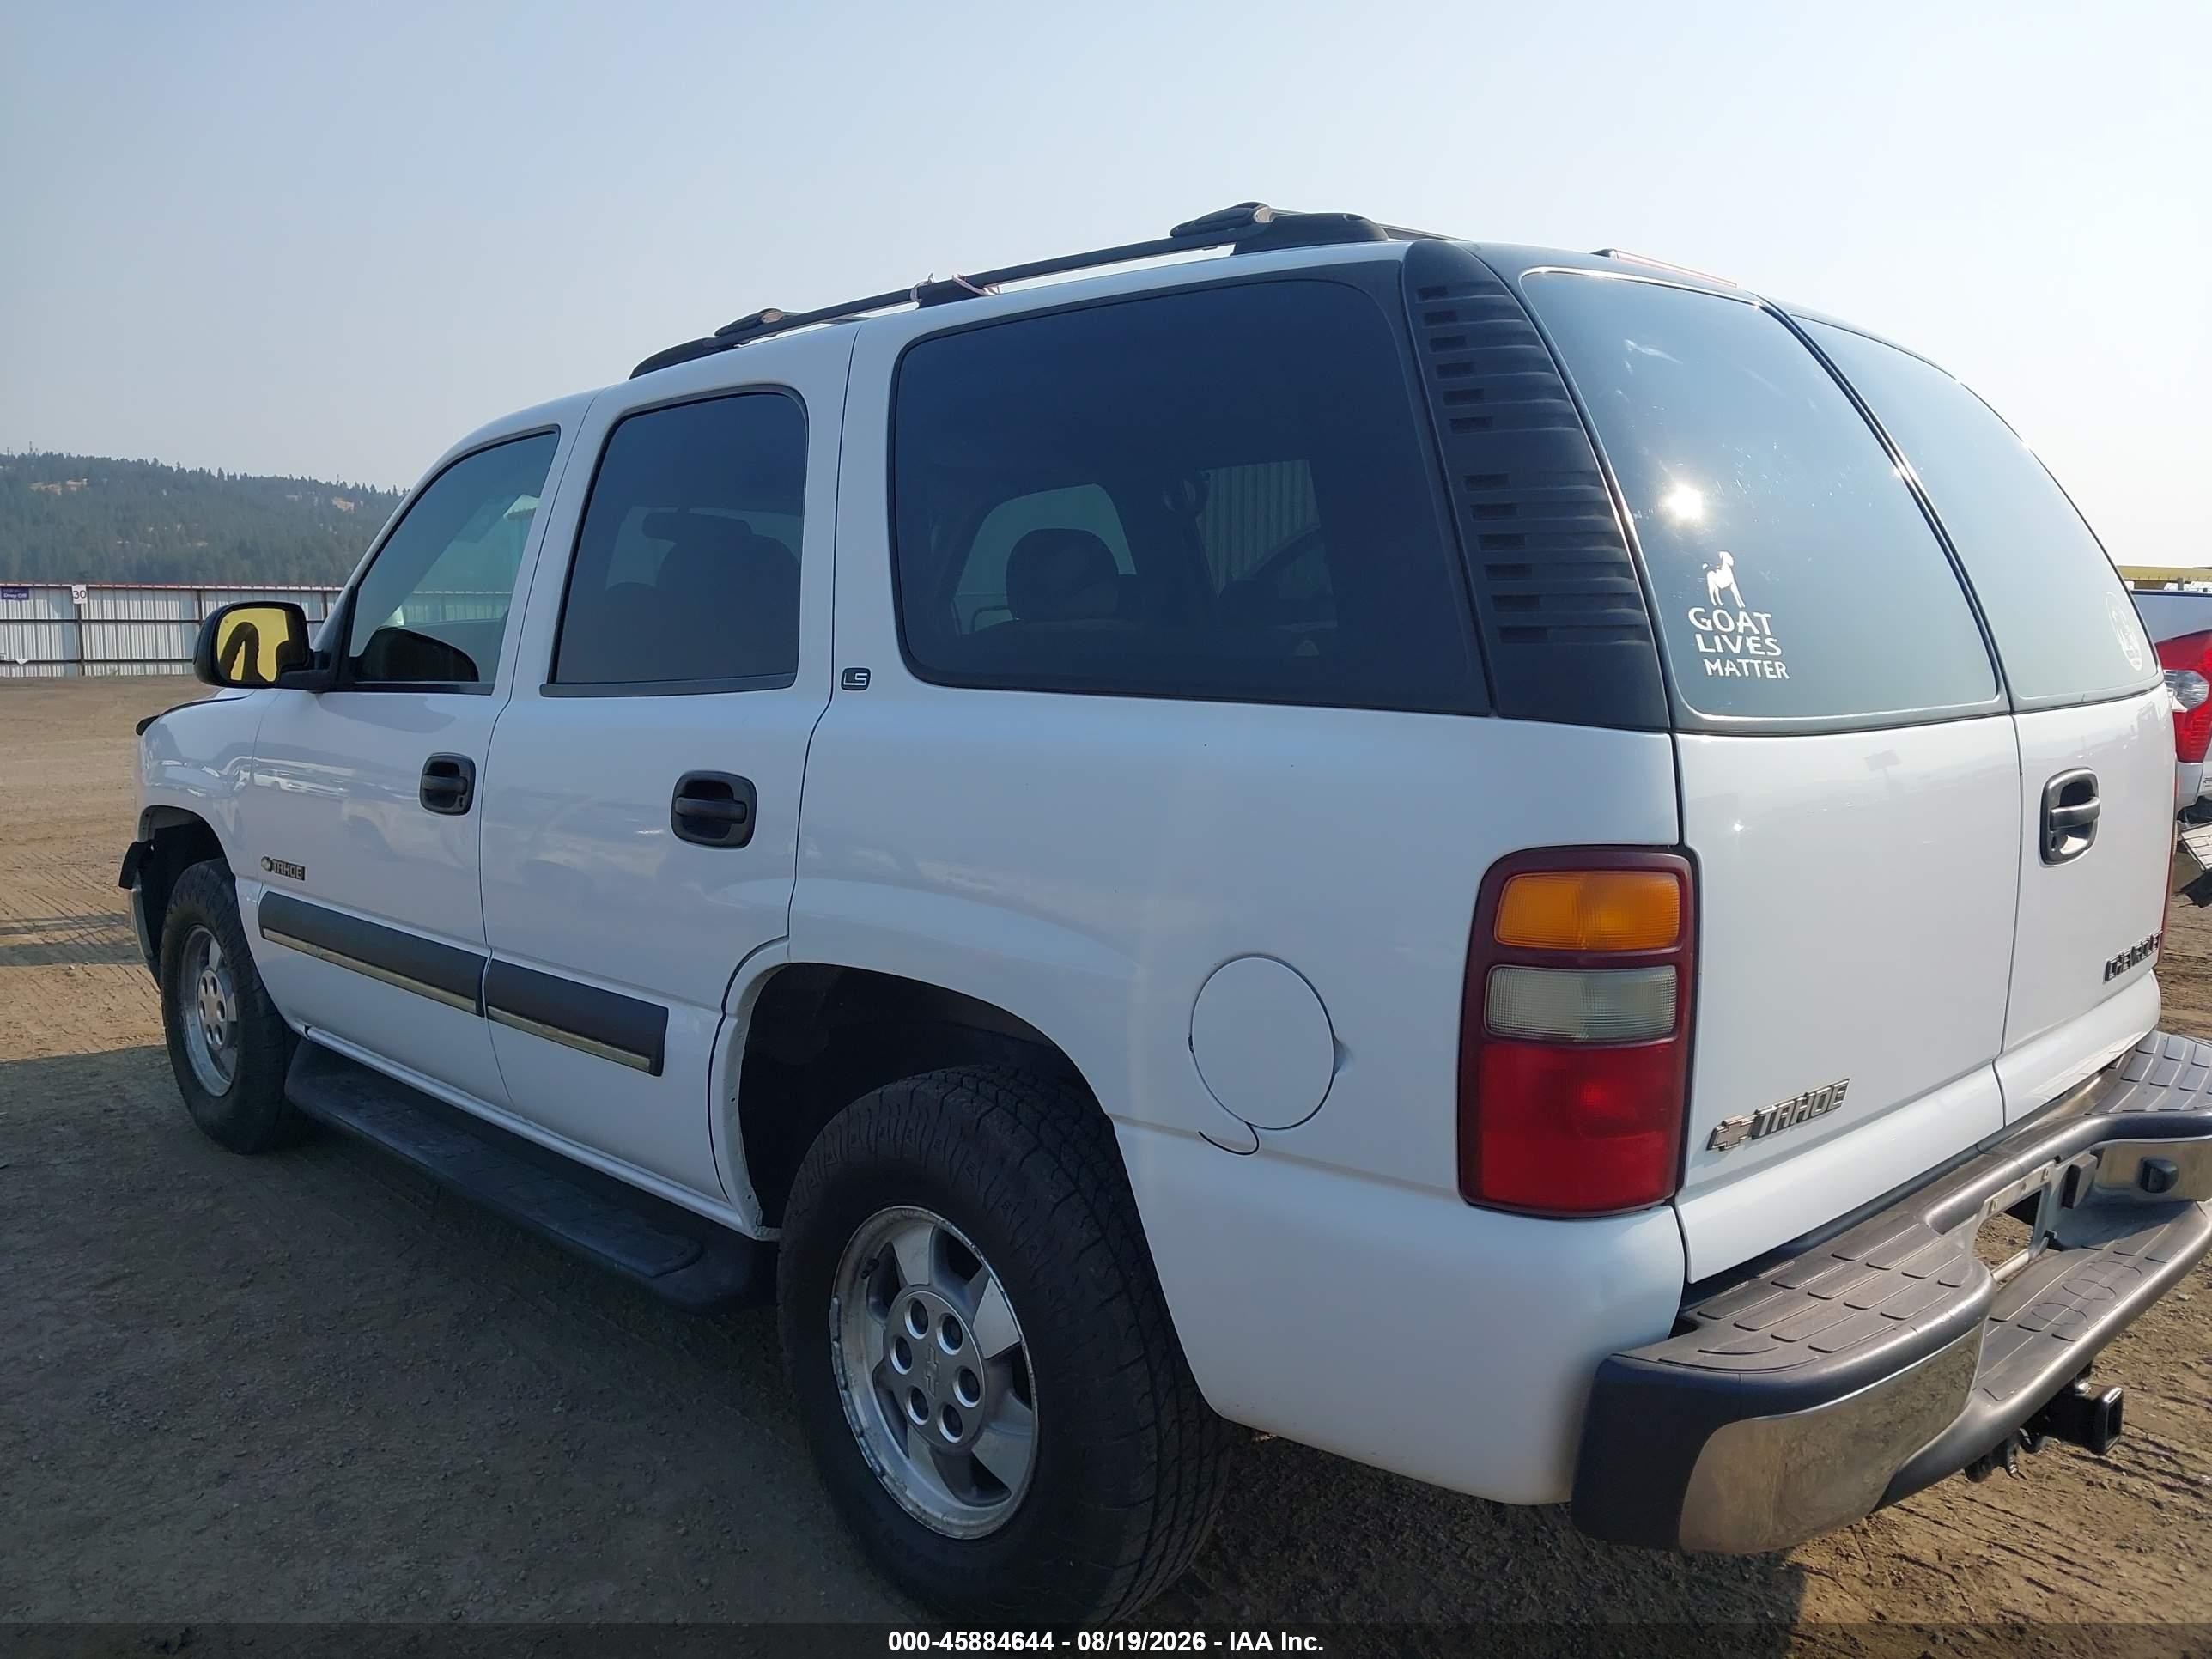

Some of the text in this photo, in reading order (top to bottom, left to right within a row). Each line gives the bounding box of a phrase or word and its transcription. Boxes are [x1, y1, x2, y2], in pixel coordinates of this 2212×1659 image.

[73, 590, 87, 599] 30
[1688, 607, 1771, 635] GOAT
[1695, 633, 1782, 656] LIVES
[1704, 658, 1790, 679] MATTER
[274, 860, 304, 879] TAHOE
[1752, 1079, 1850, 1139] TAHOE
